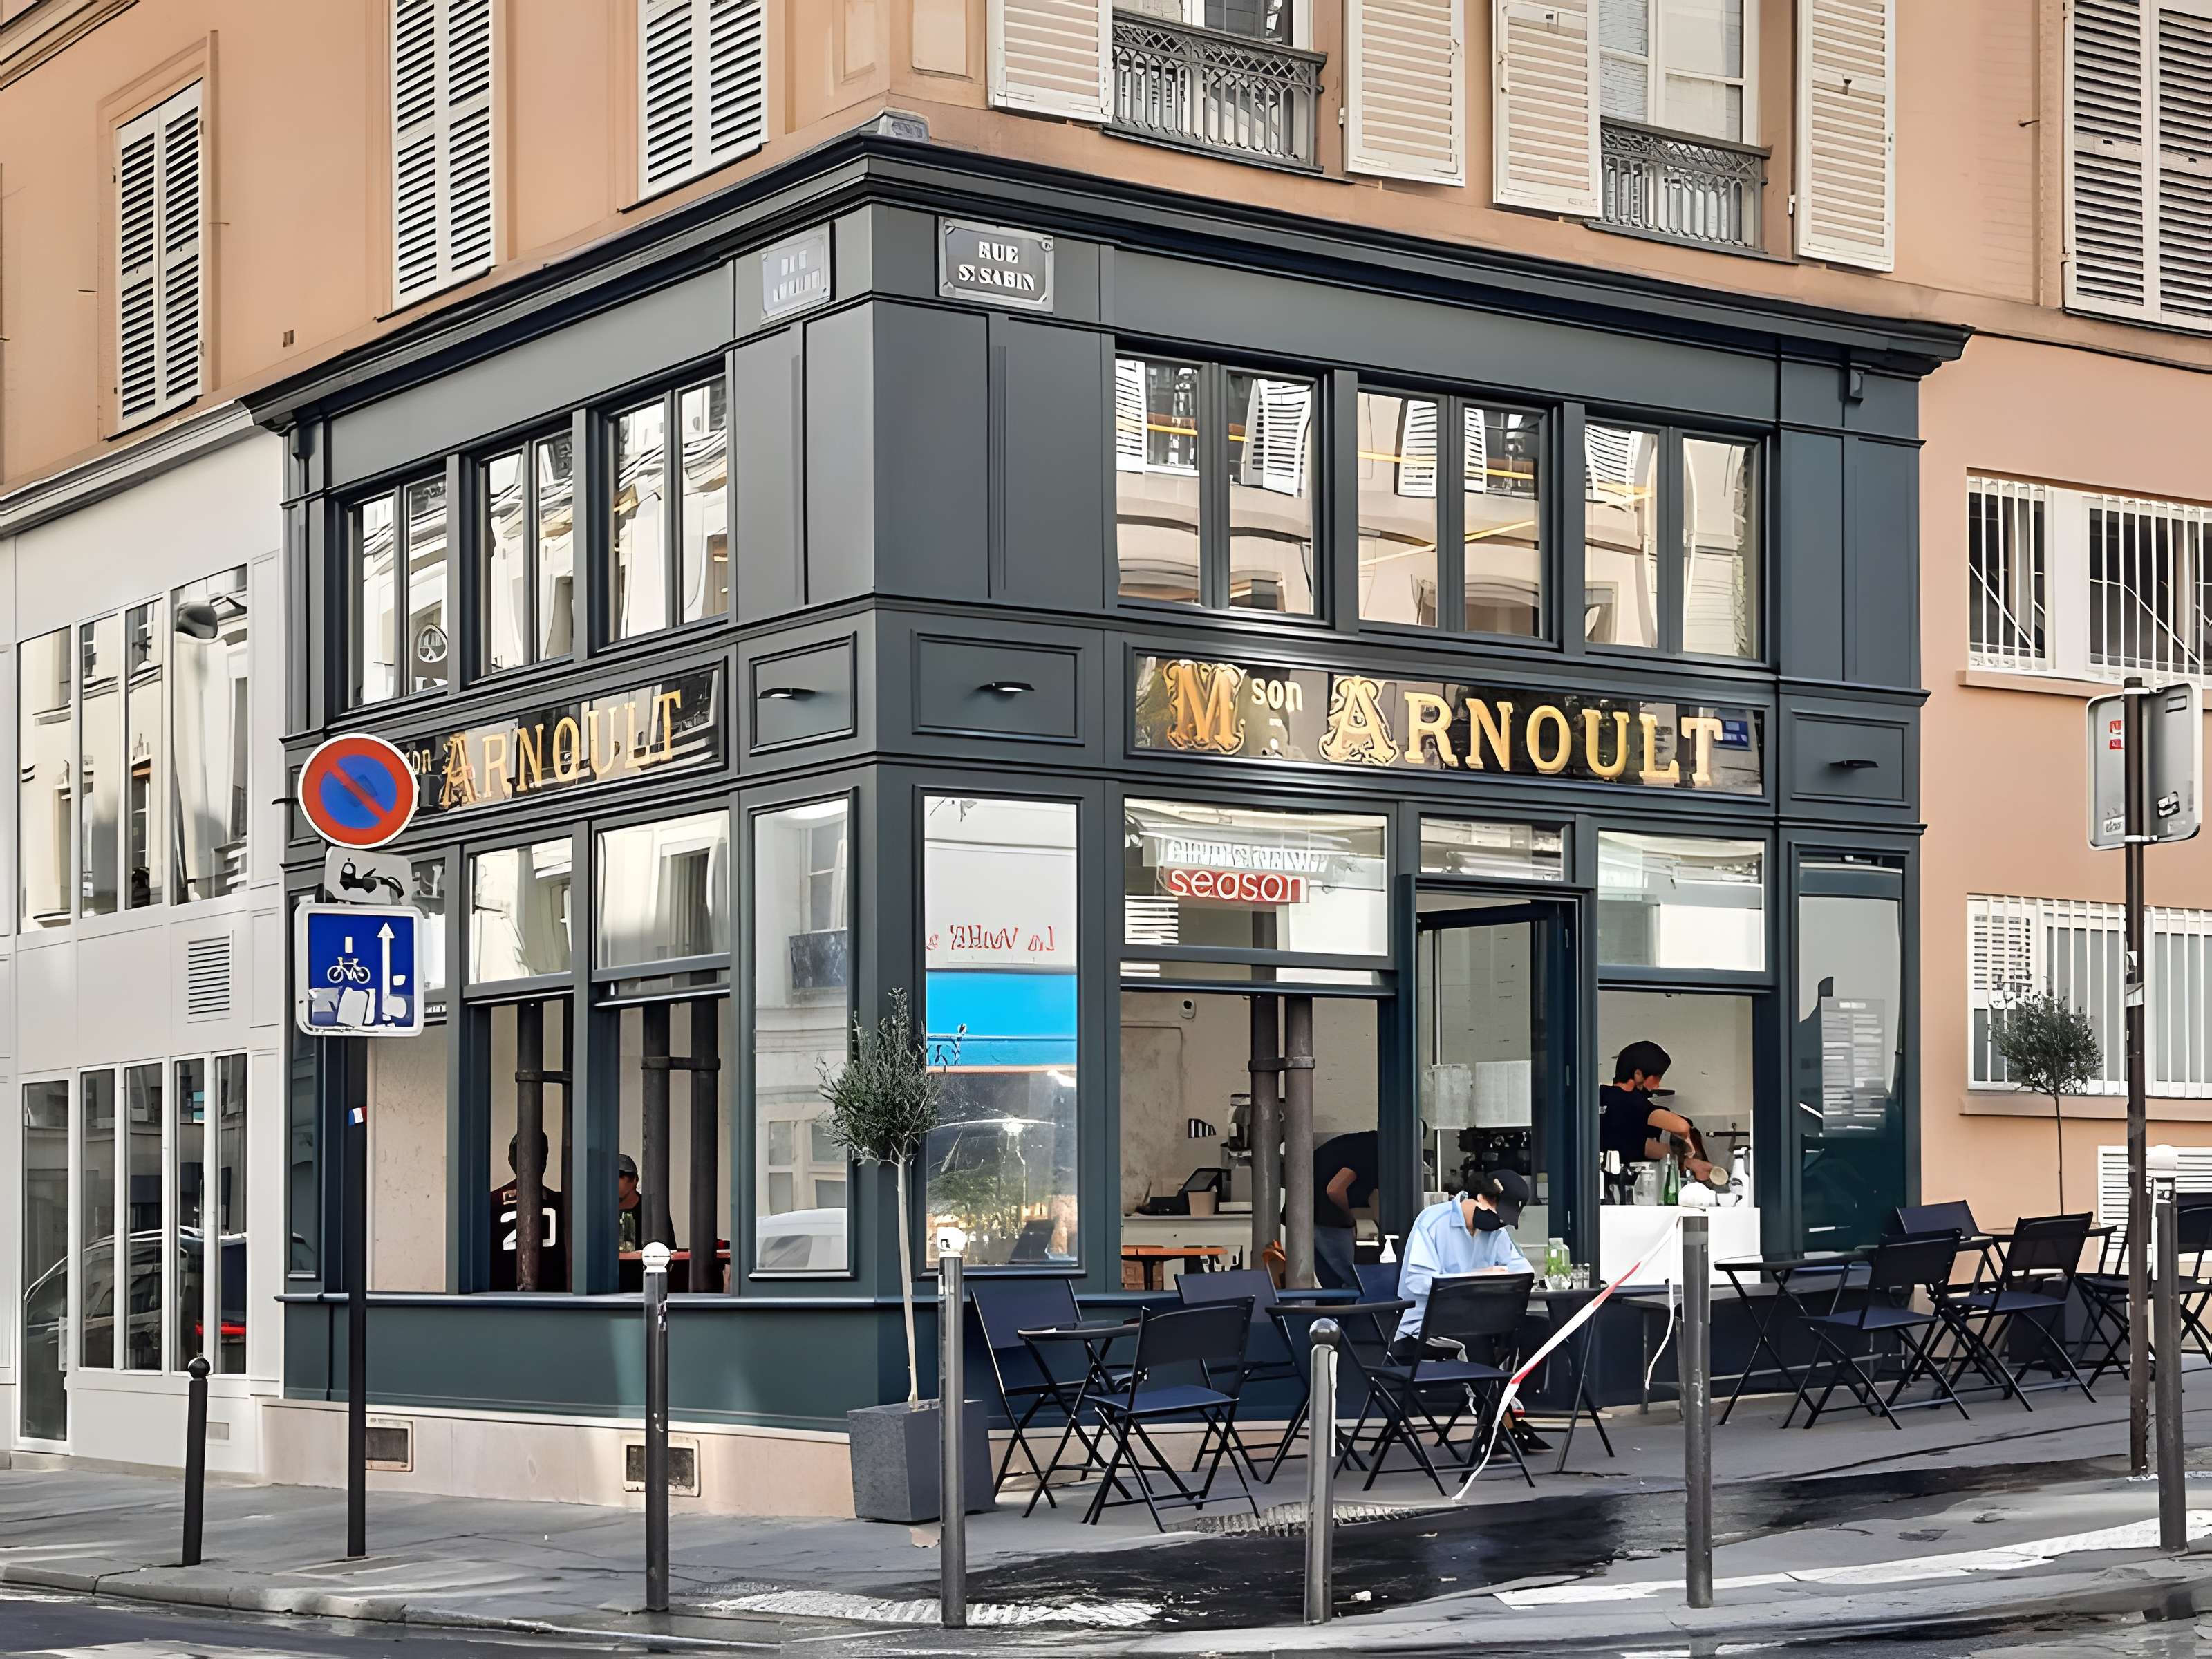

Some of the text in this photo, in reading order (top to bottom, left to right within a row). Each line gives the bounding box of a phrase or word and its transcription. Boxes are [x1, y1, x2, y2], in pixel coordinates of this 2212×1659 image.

[978, 241, 1019, 263] RUE
[439, 689, 682, 809] ARNOULT
[1319, 673, 1723, 788] ARNOULT
